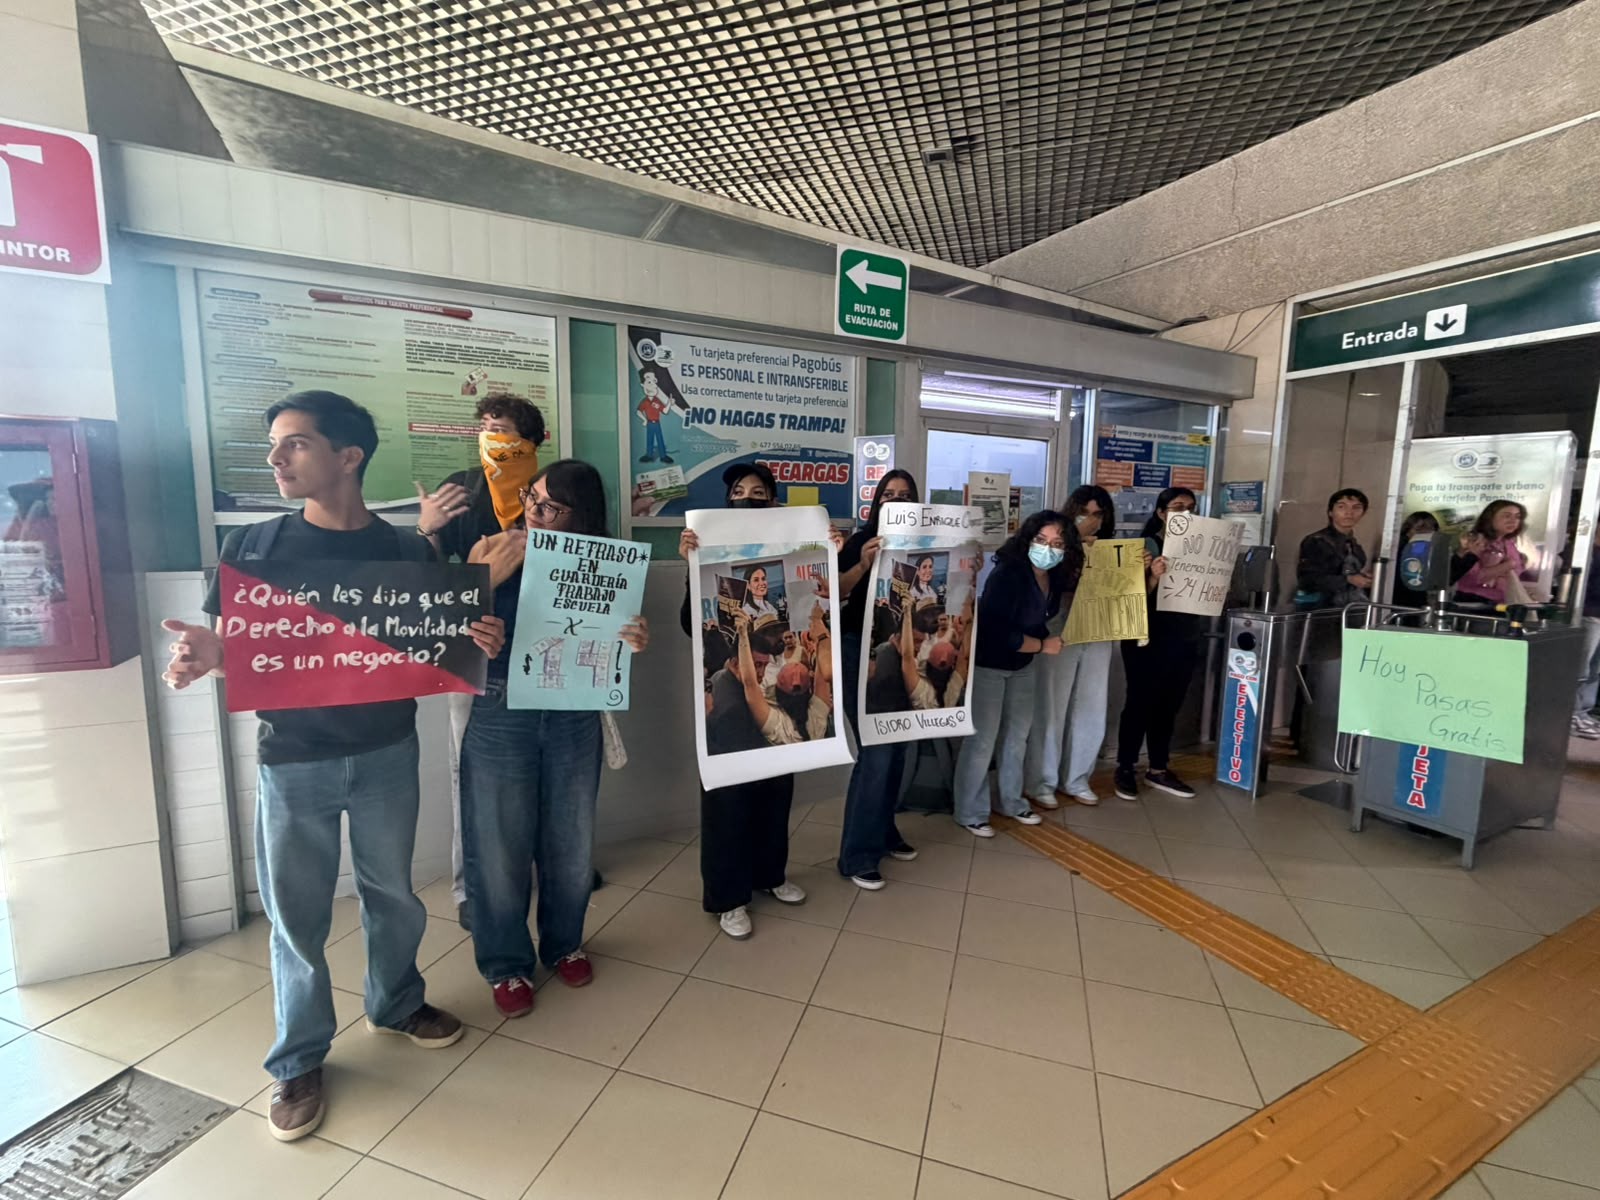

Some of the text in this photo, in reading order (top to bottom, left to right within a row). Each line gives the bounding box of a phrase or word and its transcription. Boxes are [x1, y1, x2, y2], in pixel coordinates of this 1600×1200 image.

[854, 303, 891, 317] RUTA DE
[845, 314, 898, 331] EVACUACIÓN
[1341, 321, 1418, 349] Entrada
[690, 345, 842, 373] Tu tarjeta preferencial Pagobús
[681, 363, 694, 377] ES
[698, 365, 755, 383] PERSONAL
[757, 371, 764, 384] E
[766, 372, 848, 392] INTRANSFERIBLE
[681, 384, 848, 408] Usa correctamente tu tarjeta preferencial
[684, 407, 846, 433] ¡NO HAGAS TRAMPA!
[1409, 481, 1545, 495] Paga tu transporte urbano
[533, 531, 557, 551] UN
[1183, 533, 1203, 556] NO
[577, 557, 599, 574] EN
[549, 568, 627, 590] GUARDERÍA
[1174, 577, 1197, 598] 24
[234, 583, 479, 613] ¿Quién les dijo que el
[557, 583, 616, 602] TRABAJO
[552, 597, 610, 615] ESCUELA
[225, 615, 469, 639] Derecho a la Movilidad
[251, 641, 446, 673] es un negocio?
[1359, 645, 1406, 682] Hoy
[1415, 673, 1493, 718] Pasas
[874, 717, 911, 735] ISIDRO
[1229, 683, 1248, 782] EFECTIVO
[1429, 715, 1507, 752] Gratis
